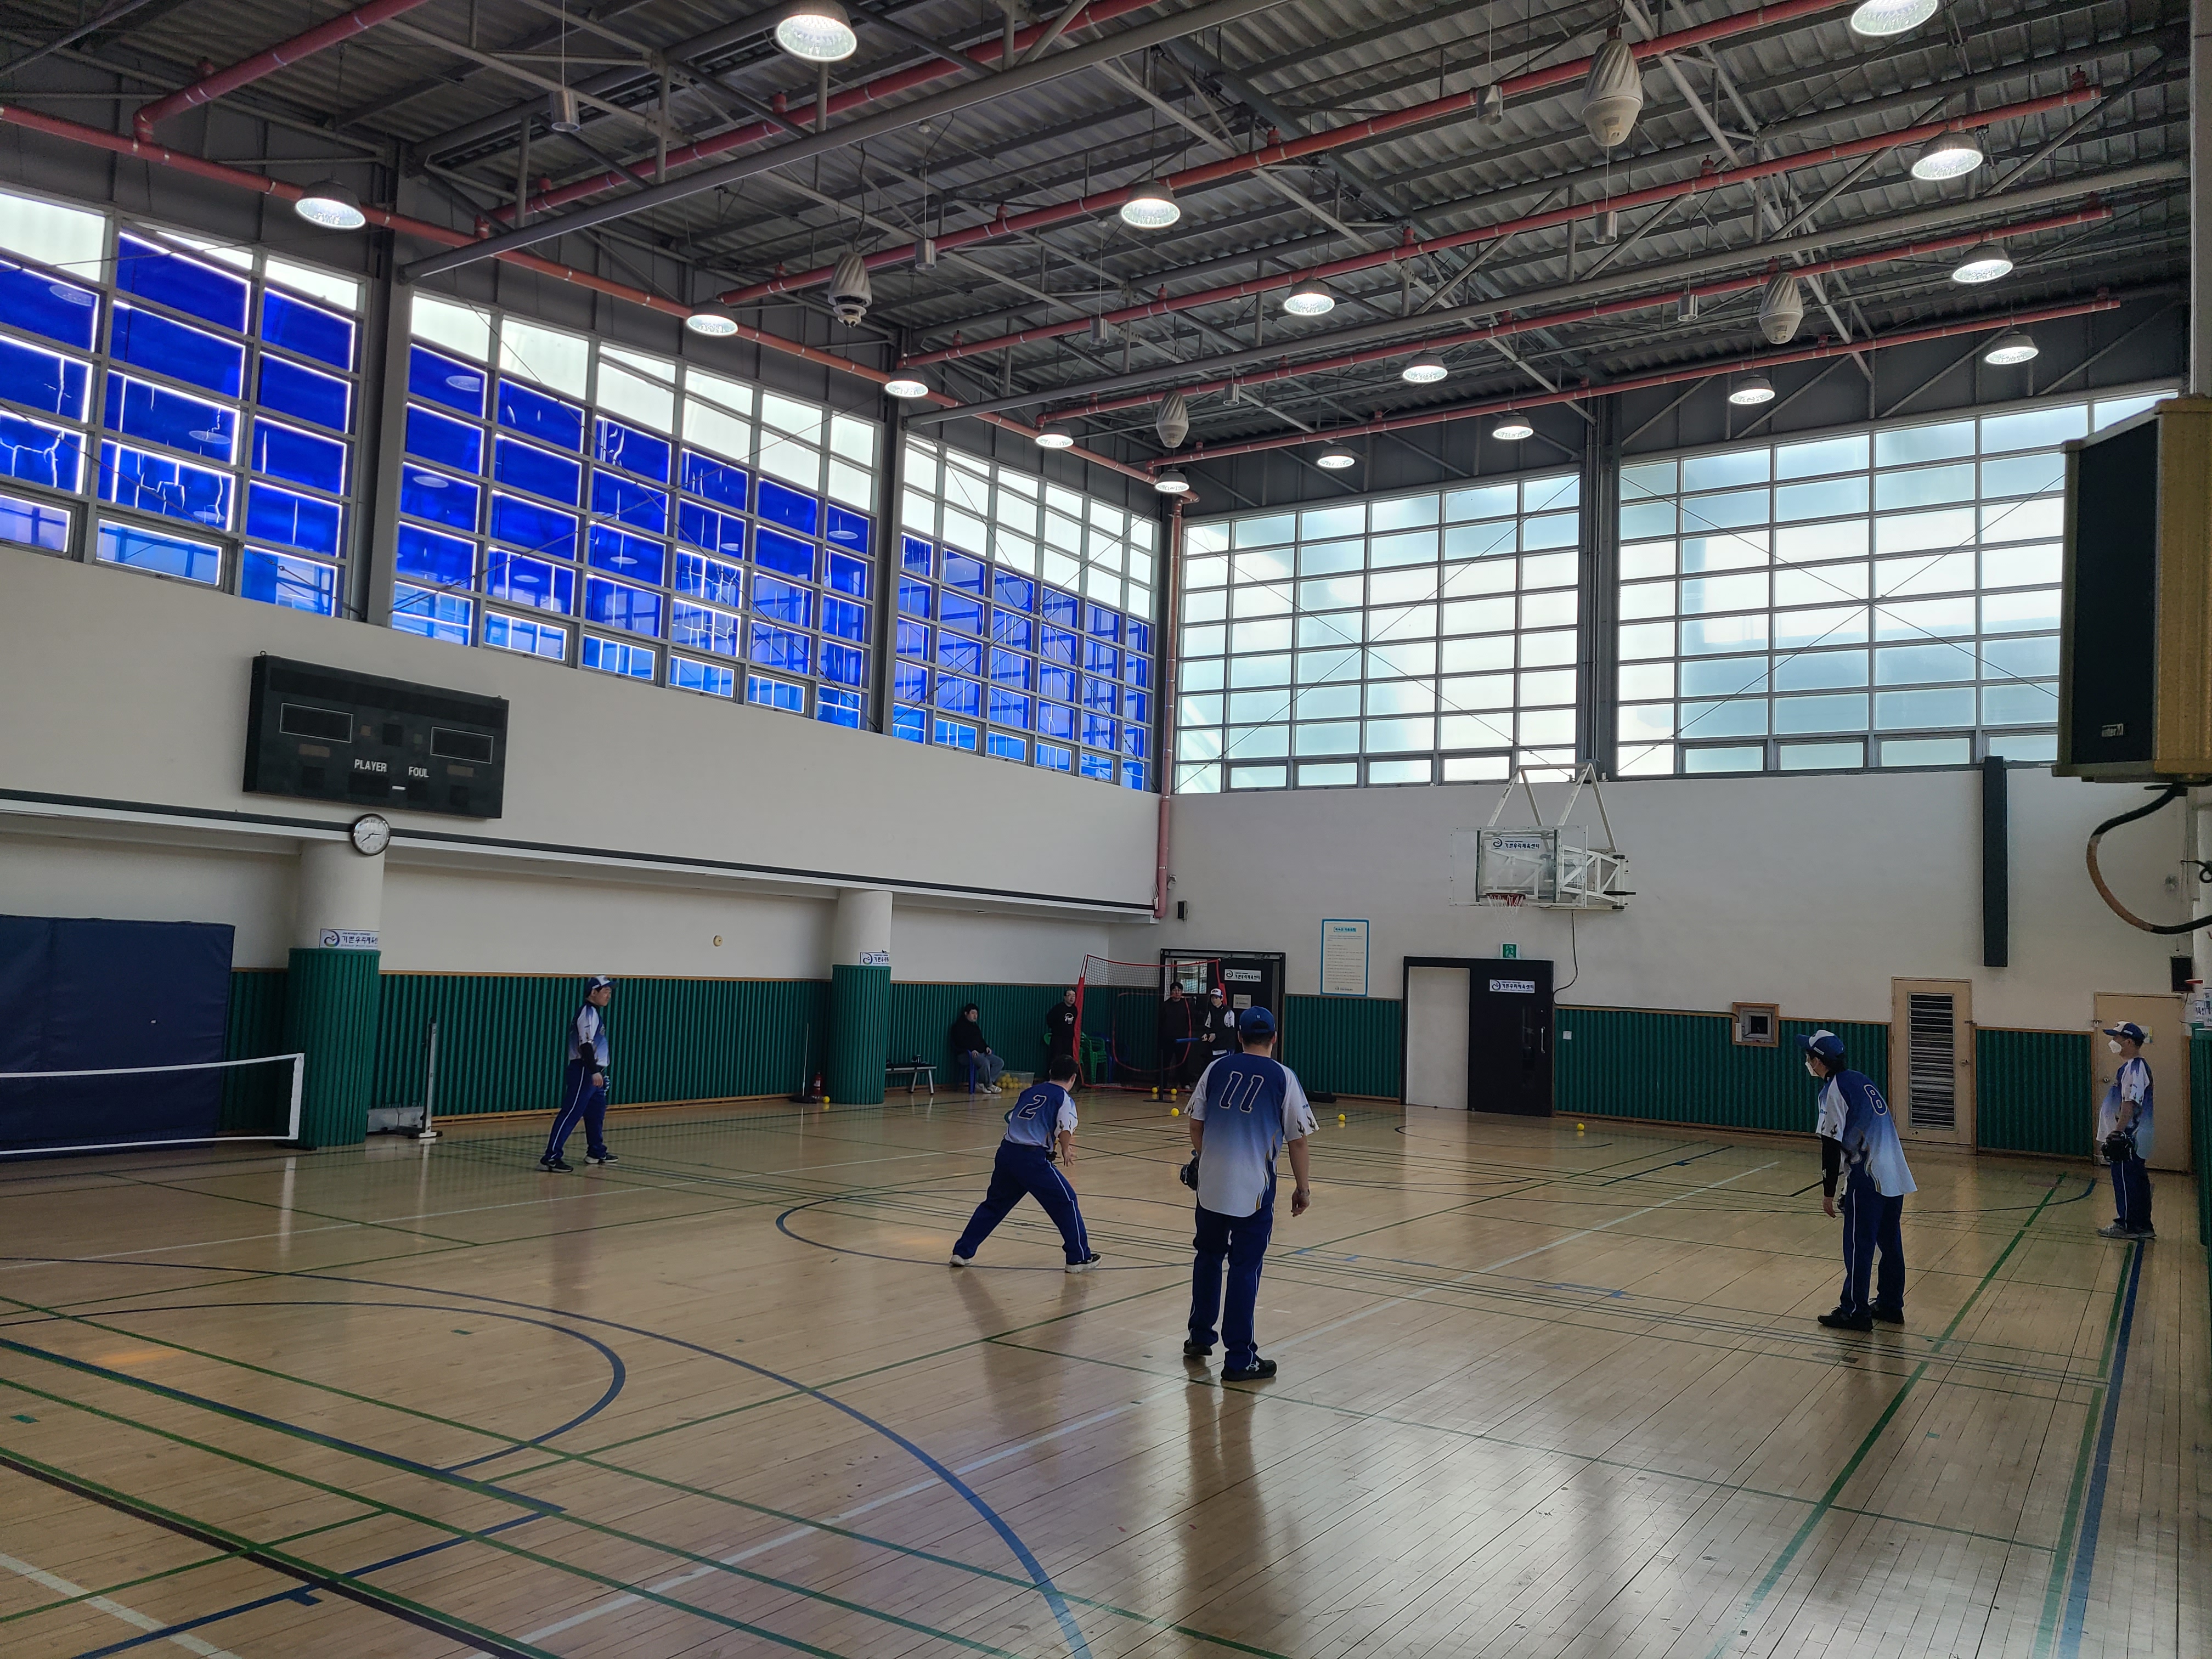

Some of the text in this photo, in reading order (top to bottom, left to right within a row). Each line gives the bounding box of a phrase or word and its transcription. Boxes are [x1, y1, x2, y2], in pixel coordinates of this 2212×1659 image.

[354, 759, 387, 772] PLAYER
[408, 766, 429, 777] FOUL
[1219, 1071, 1264, 1113] 11
[1864, 1084, 1888, 1115] 8
[1018, 1094, 1047, 1120] 2
